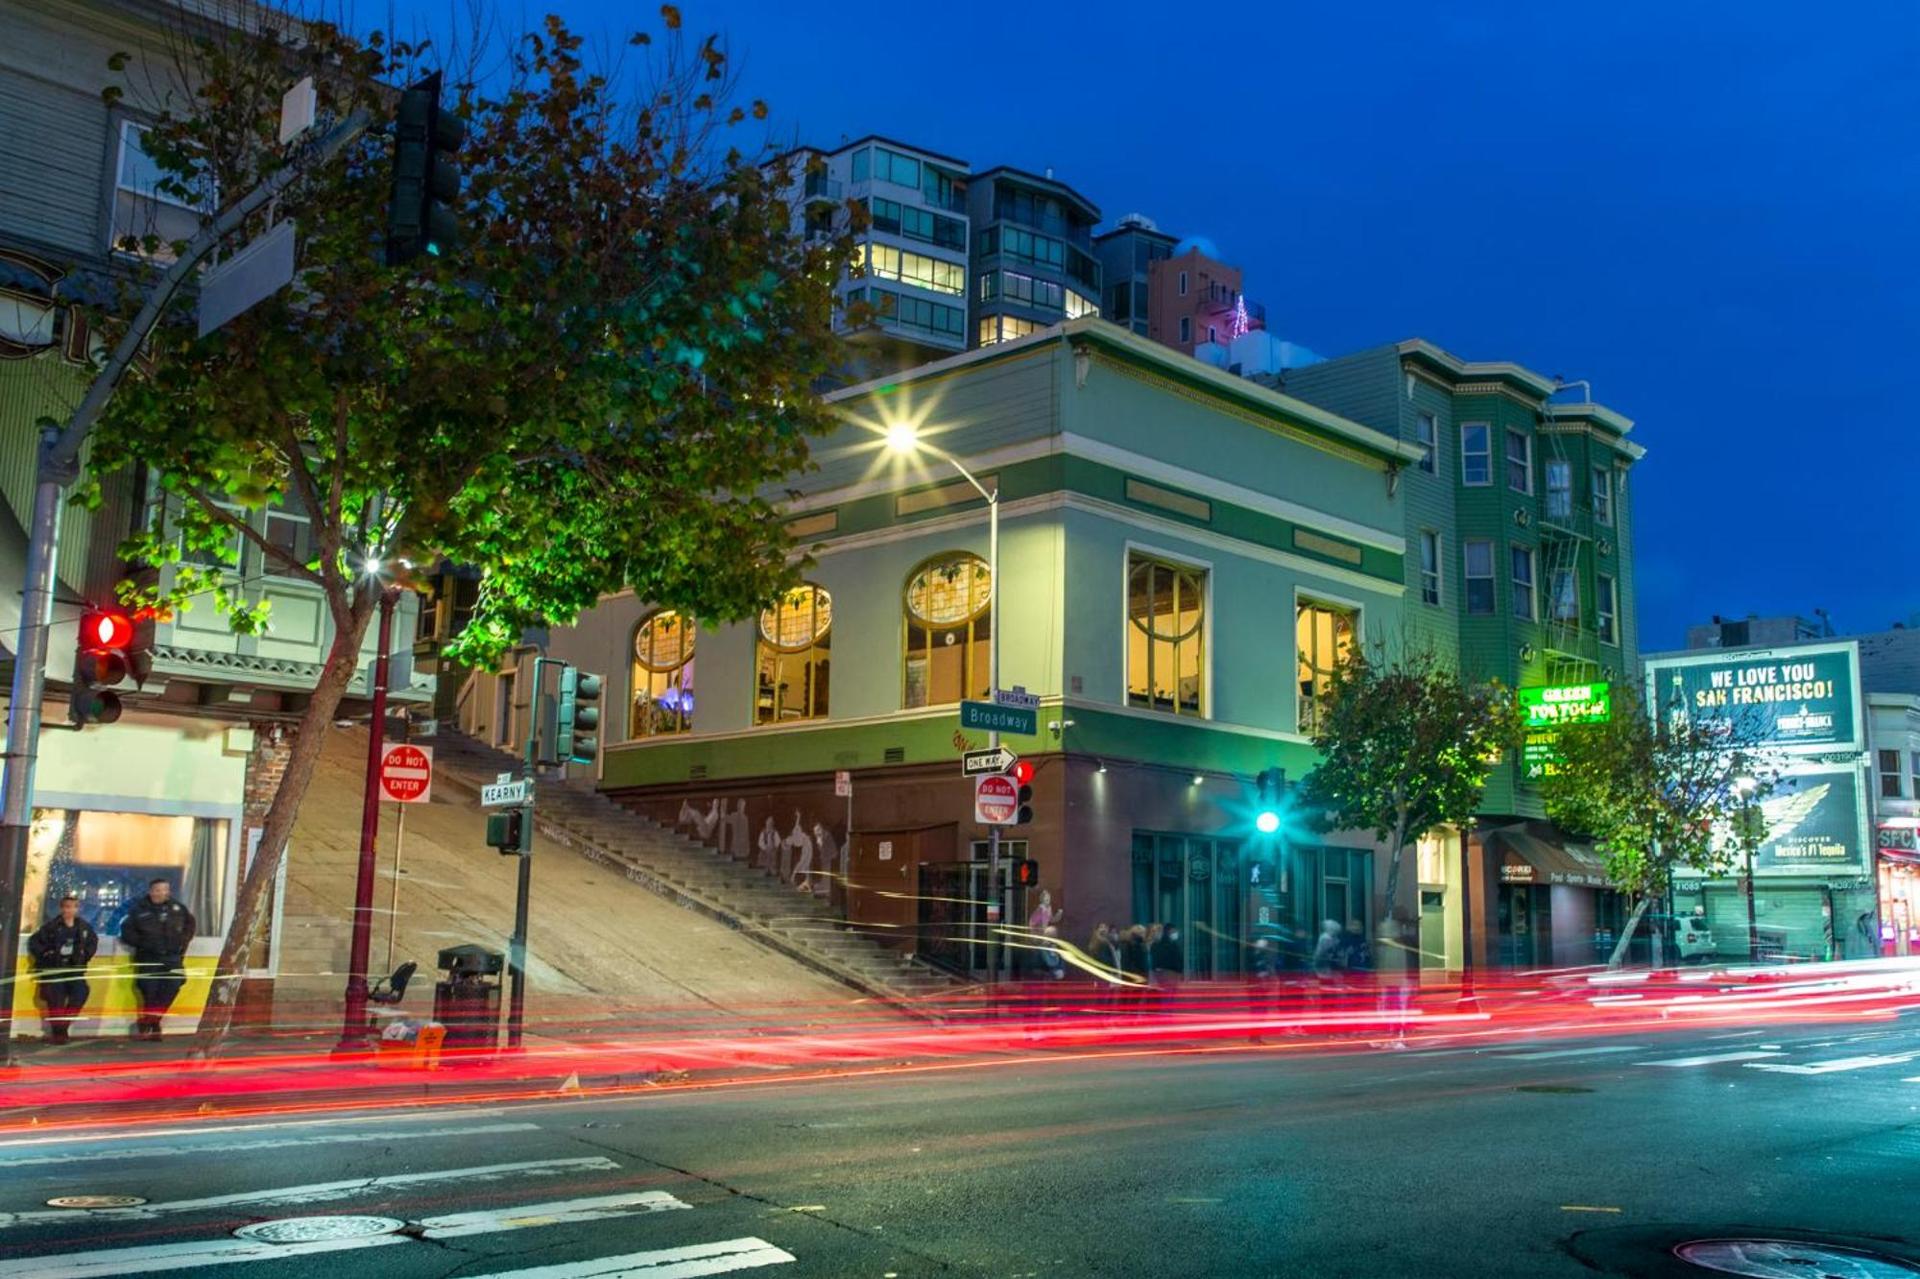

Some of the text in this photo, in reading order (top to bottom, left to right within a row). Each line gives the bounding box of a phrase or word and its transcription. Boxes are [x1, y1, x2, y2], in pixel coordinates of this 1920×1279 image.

[1710, 663, 1815, 688] WE LOVE YOU
[1696, 680, 1833, 707] SAN FRANCISCO!
[970, 708, 1028, 731] Broadway
[388, 755, 423, 767] DO NOT
[968, 757, 1000, 769] ONE WAY
[390, 780, 419, 791] ENTER
[982, 785, 1011, 794] DO NOT
[484, 785, 522, 802] KEARNY
[984, 806, 1009, 814] ENTER
[1775, 844, 1807, 857] Mexico's
[1818, 843, 1846, 858] Tequila
